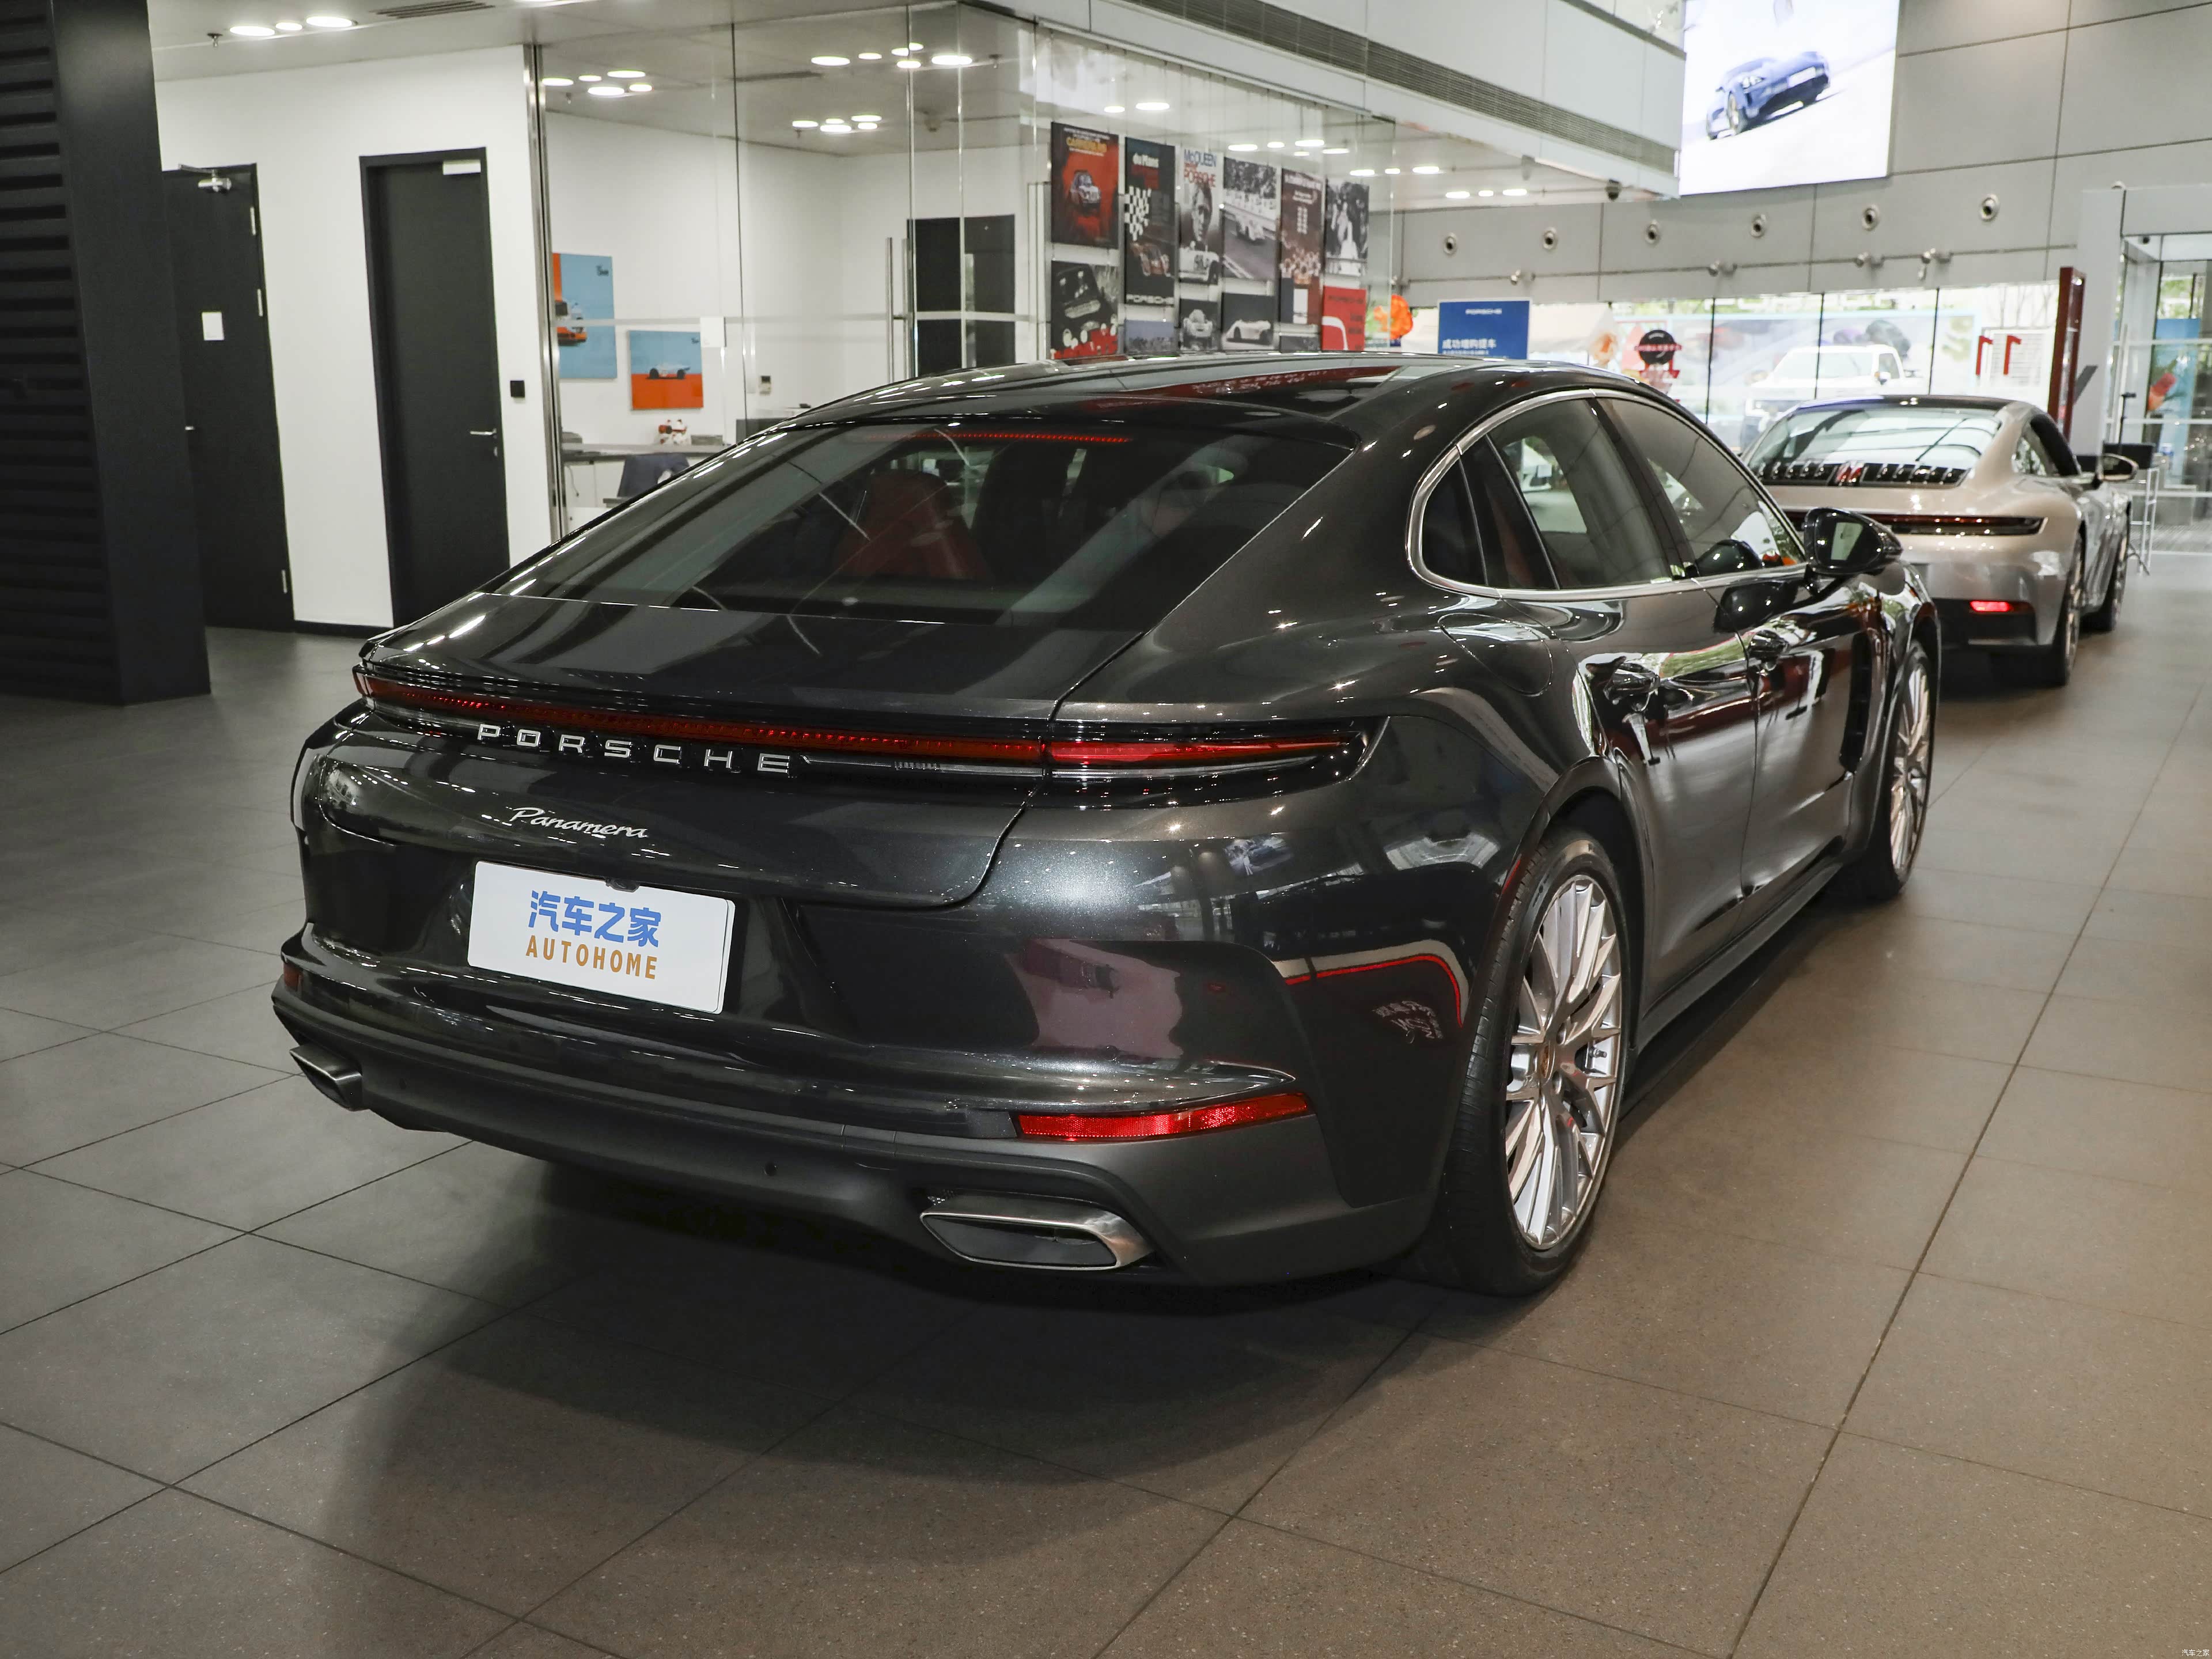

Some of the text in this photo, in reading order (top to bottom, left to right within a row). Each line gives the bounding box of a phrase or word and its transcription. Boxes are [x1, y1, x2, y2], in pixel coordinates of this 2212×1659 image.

[1126, 294, 1175, 304] PORSCHE
[478, 723, 791, 774] PORSCHE
[509, 806, 648, 839] Panamera
[528, 890, 661, 947] 汽车之家
[526, 935, 657, 979] AUTOHOME
